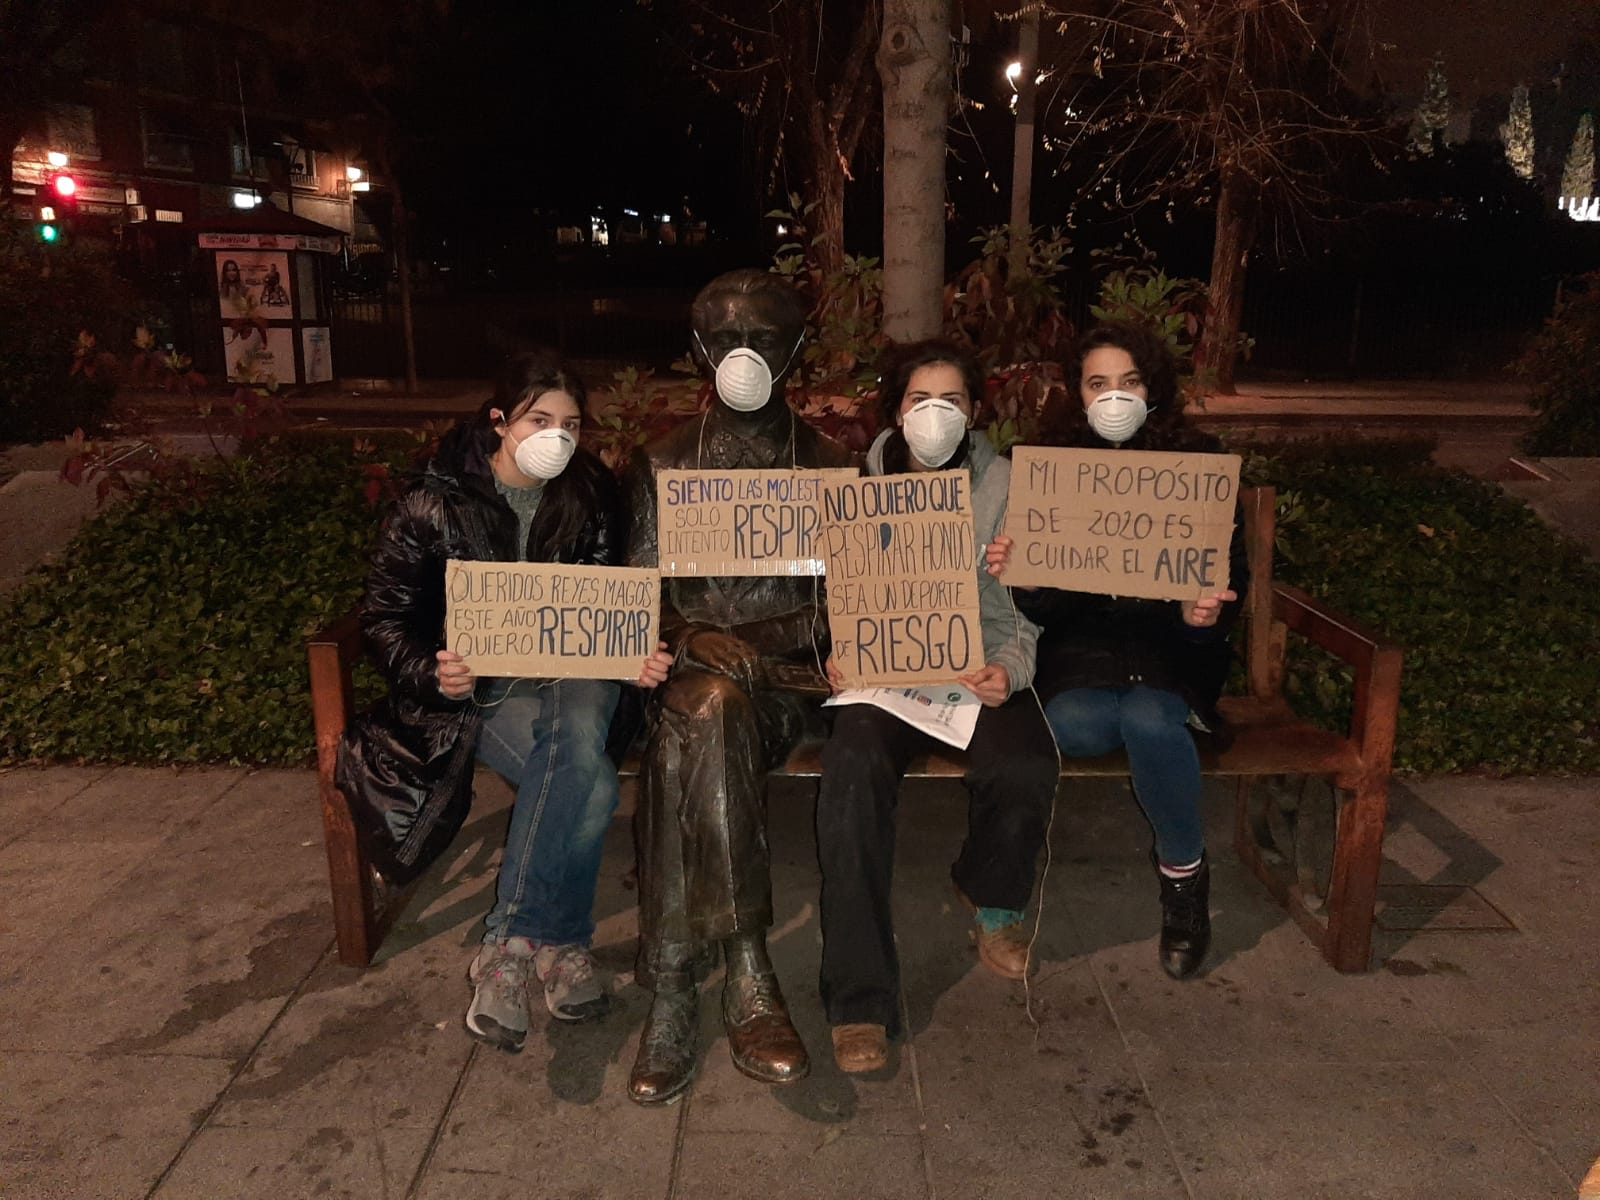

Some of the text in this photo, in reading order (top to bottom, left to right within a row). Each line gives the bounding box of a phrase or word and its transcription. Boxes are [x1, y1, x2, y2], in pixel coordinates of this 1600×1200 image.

[667, 478, 824, 506] SIENTO LAS MOLEST
[824, 476, 965, 522] NO QUIERO QUE
[1030, 460, 1231, 502] MI PROPÓSITO
[675, 507, 721, 528] SOLO
[1027, 507, 1194, 540] DE 2020 ES
[666, 529, 730, 554] INTENTO
[824, 520, 973, 580] RESPIRAR HONDO
[1026, 542, 1218, 587] CUIDAR EL AIRE
[450, 566, 653, 608] QUERIDOS REYES MAGOS
[832, 580, 966, 616] SEA UN DEPORTE
[453, 606, 651, 657] ESTE AÑO RESPIRAR
[455, 632, 534, 658] QUIERO
[835, 612, 970, 676] DE RIESGO
